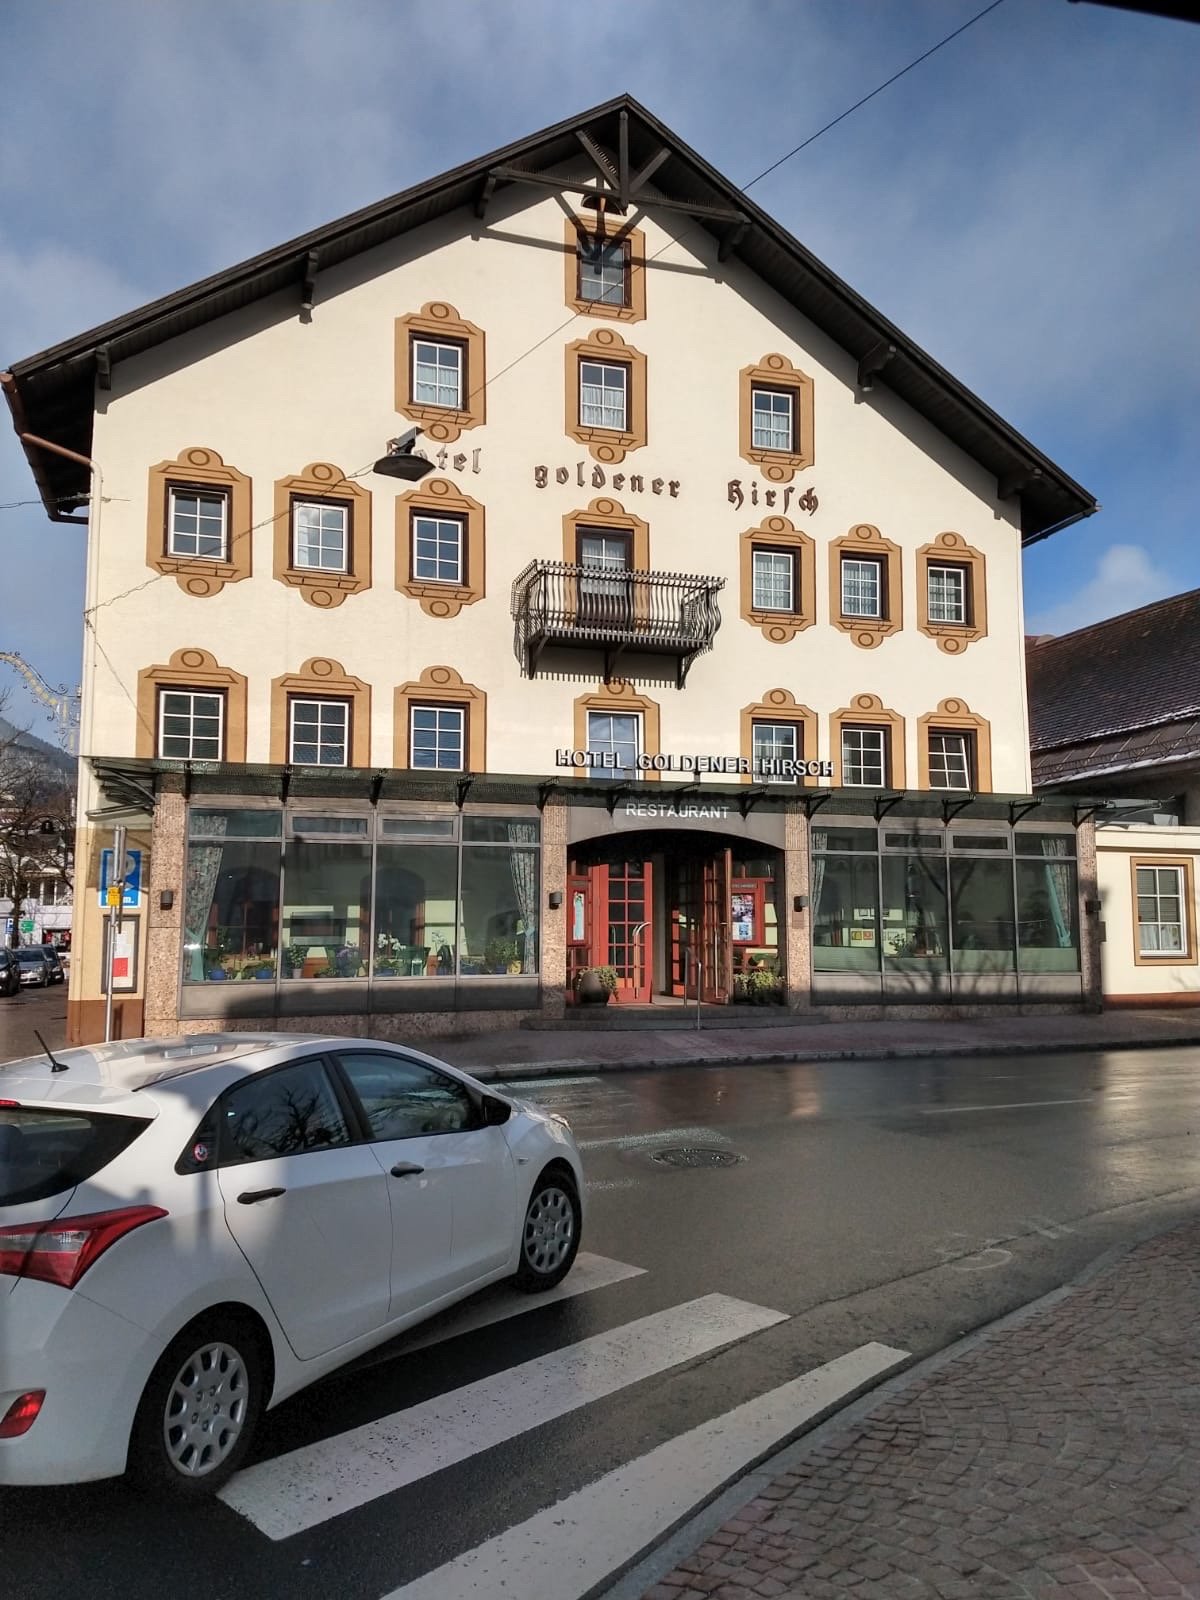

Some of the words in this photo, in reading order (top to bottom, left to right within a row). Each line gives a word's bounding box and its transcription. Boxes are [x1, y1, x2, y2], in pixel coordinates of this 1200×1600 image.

[390, 444, 482, 474] otel
[534, 461, 681, 498] goldener
[556, 749, 628, 769] HOTEL
[637, 753, 751, 774] GOLDENER
[760, 757, 835, 777] HIRSCH
[625, 802, 730, 819] RESTAURANT
